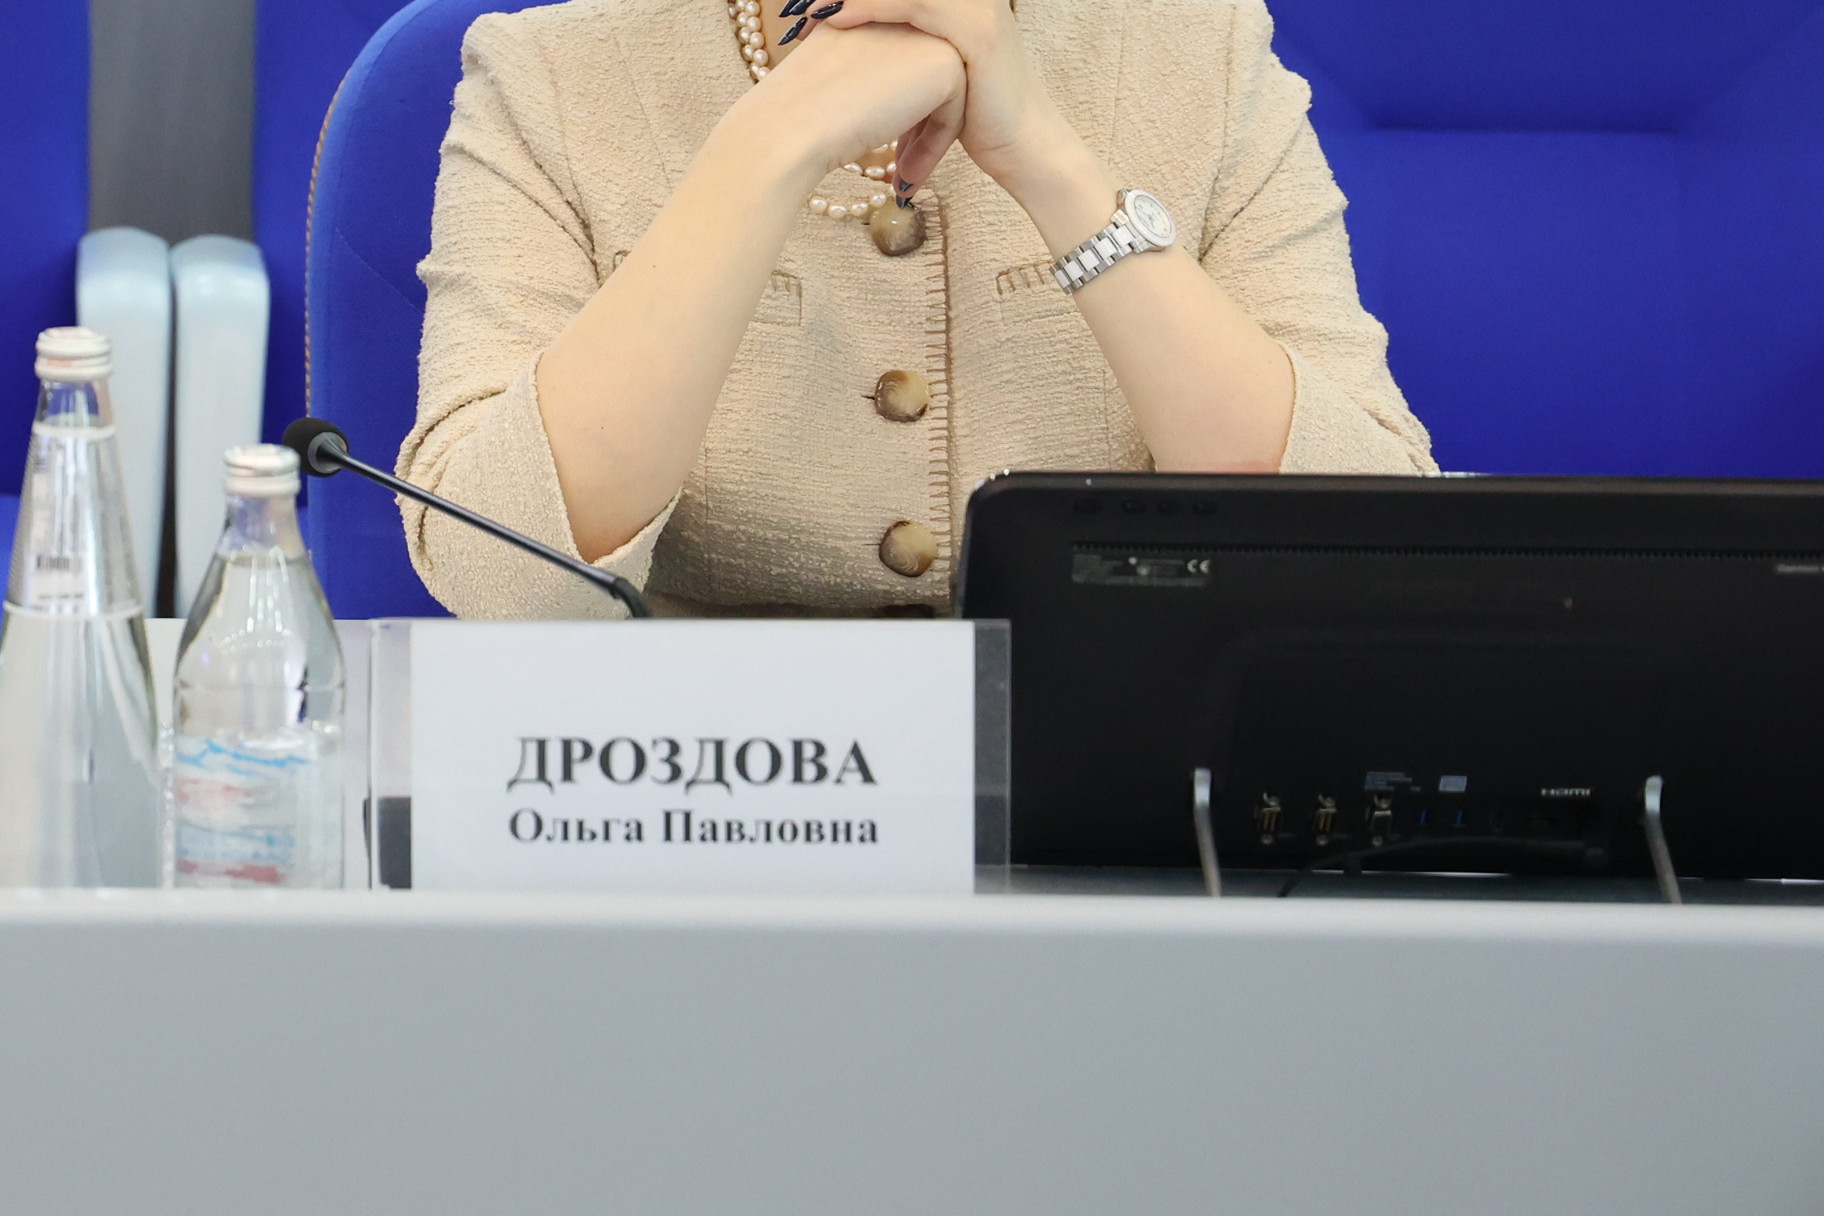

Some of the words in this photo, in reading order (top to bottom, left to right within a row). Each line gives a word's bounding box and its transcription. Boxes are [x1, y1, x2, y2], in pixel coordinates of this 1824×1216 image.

[507, 737, 877, 793] ДРОЗДОВА
[508, 810, 644, 844] Ольга
[663, 810, 879, 845] Павловна
